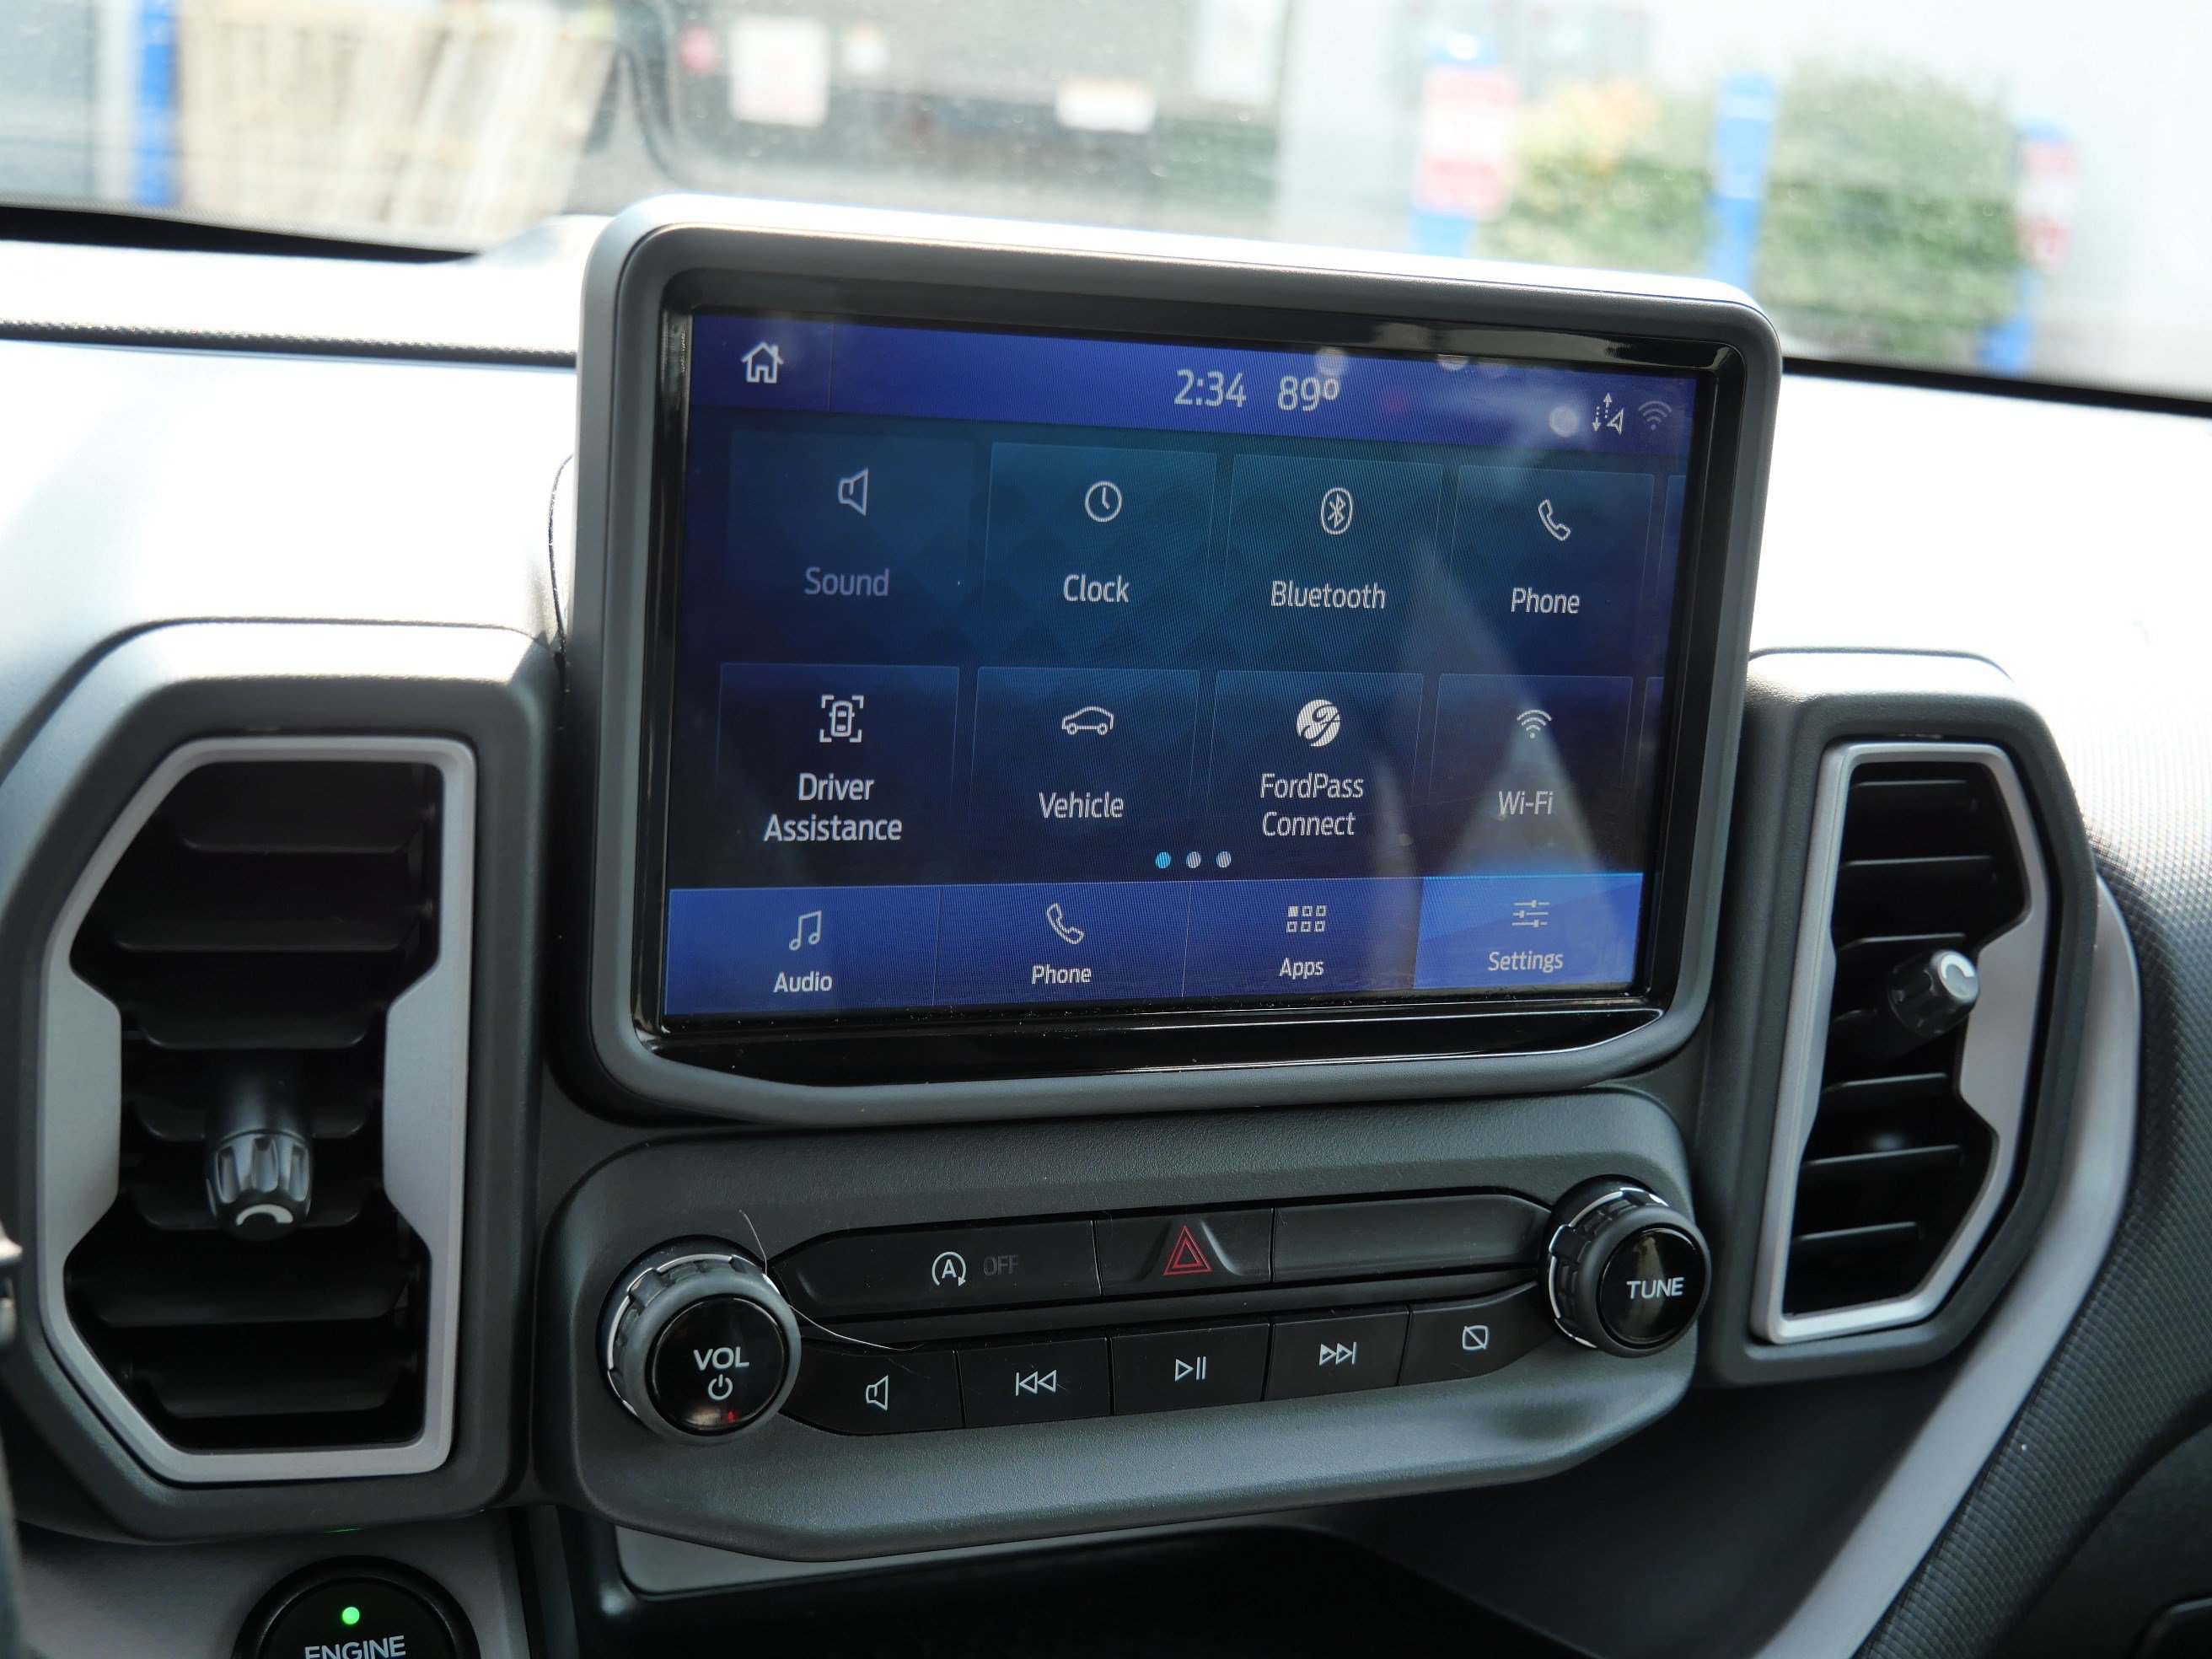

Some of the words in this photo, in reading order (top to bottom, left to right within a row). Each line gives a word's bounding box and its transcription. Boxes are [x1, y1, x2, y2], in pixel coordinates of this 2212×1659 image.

[1173, 369, 1247, 408] 2:34
[803, 566, 890, 597] Sound
[1062, 573, 1130, 604] Clock
[1270, 579, 1387, 610] Bluetooth
[1511, 587, 1581, 614] Phone
[797, 772, 875, 802] Driver
[1259, 773, 1364, 799] FordPass
[1038, 791, 1125, 819] Vehicle
[1497, 790, 1554, 816] Wi-Fi
[763, 813, 903, 843] Assistance
[1262, 812, 1356, 837] Connect
[1031, 964, 1092, 985] Phone
[1279, 958, 1325, 981] Apps
[1487, 951, 1564, 974] Settings
[773, 971, 833, 994] Audio
[982, 1254, 1018, 1276] OFF
[1626, 1277, 1684, 1299] TUNE
[693, 1346, 750, 1371] VOL
[304, 1635, 406, 1659] ENGINE
